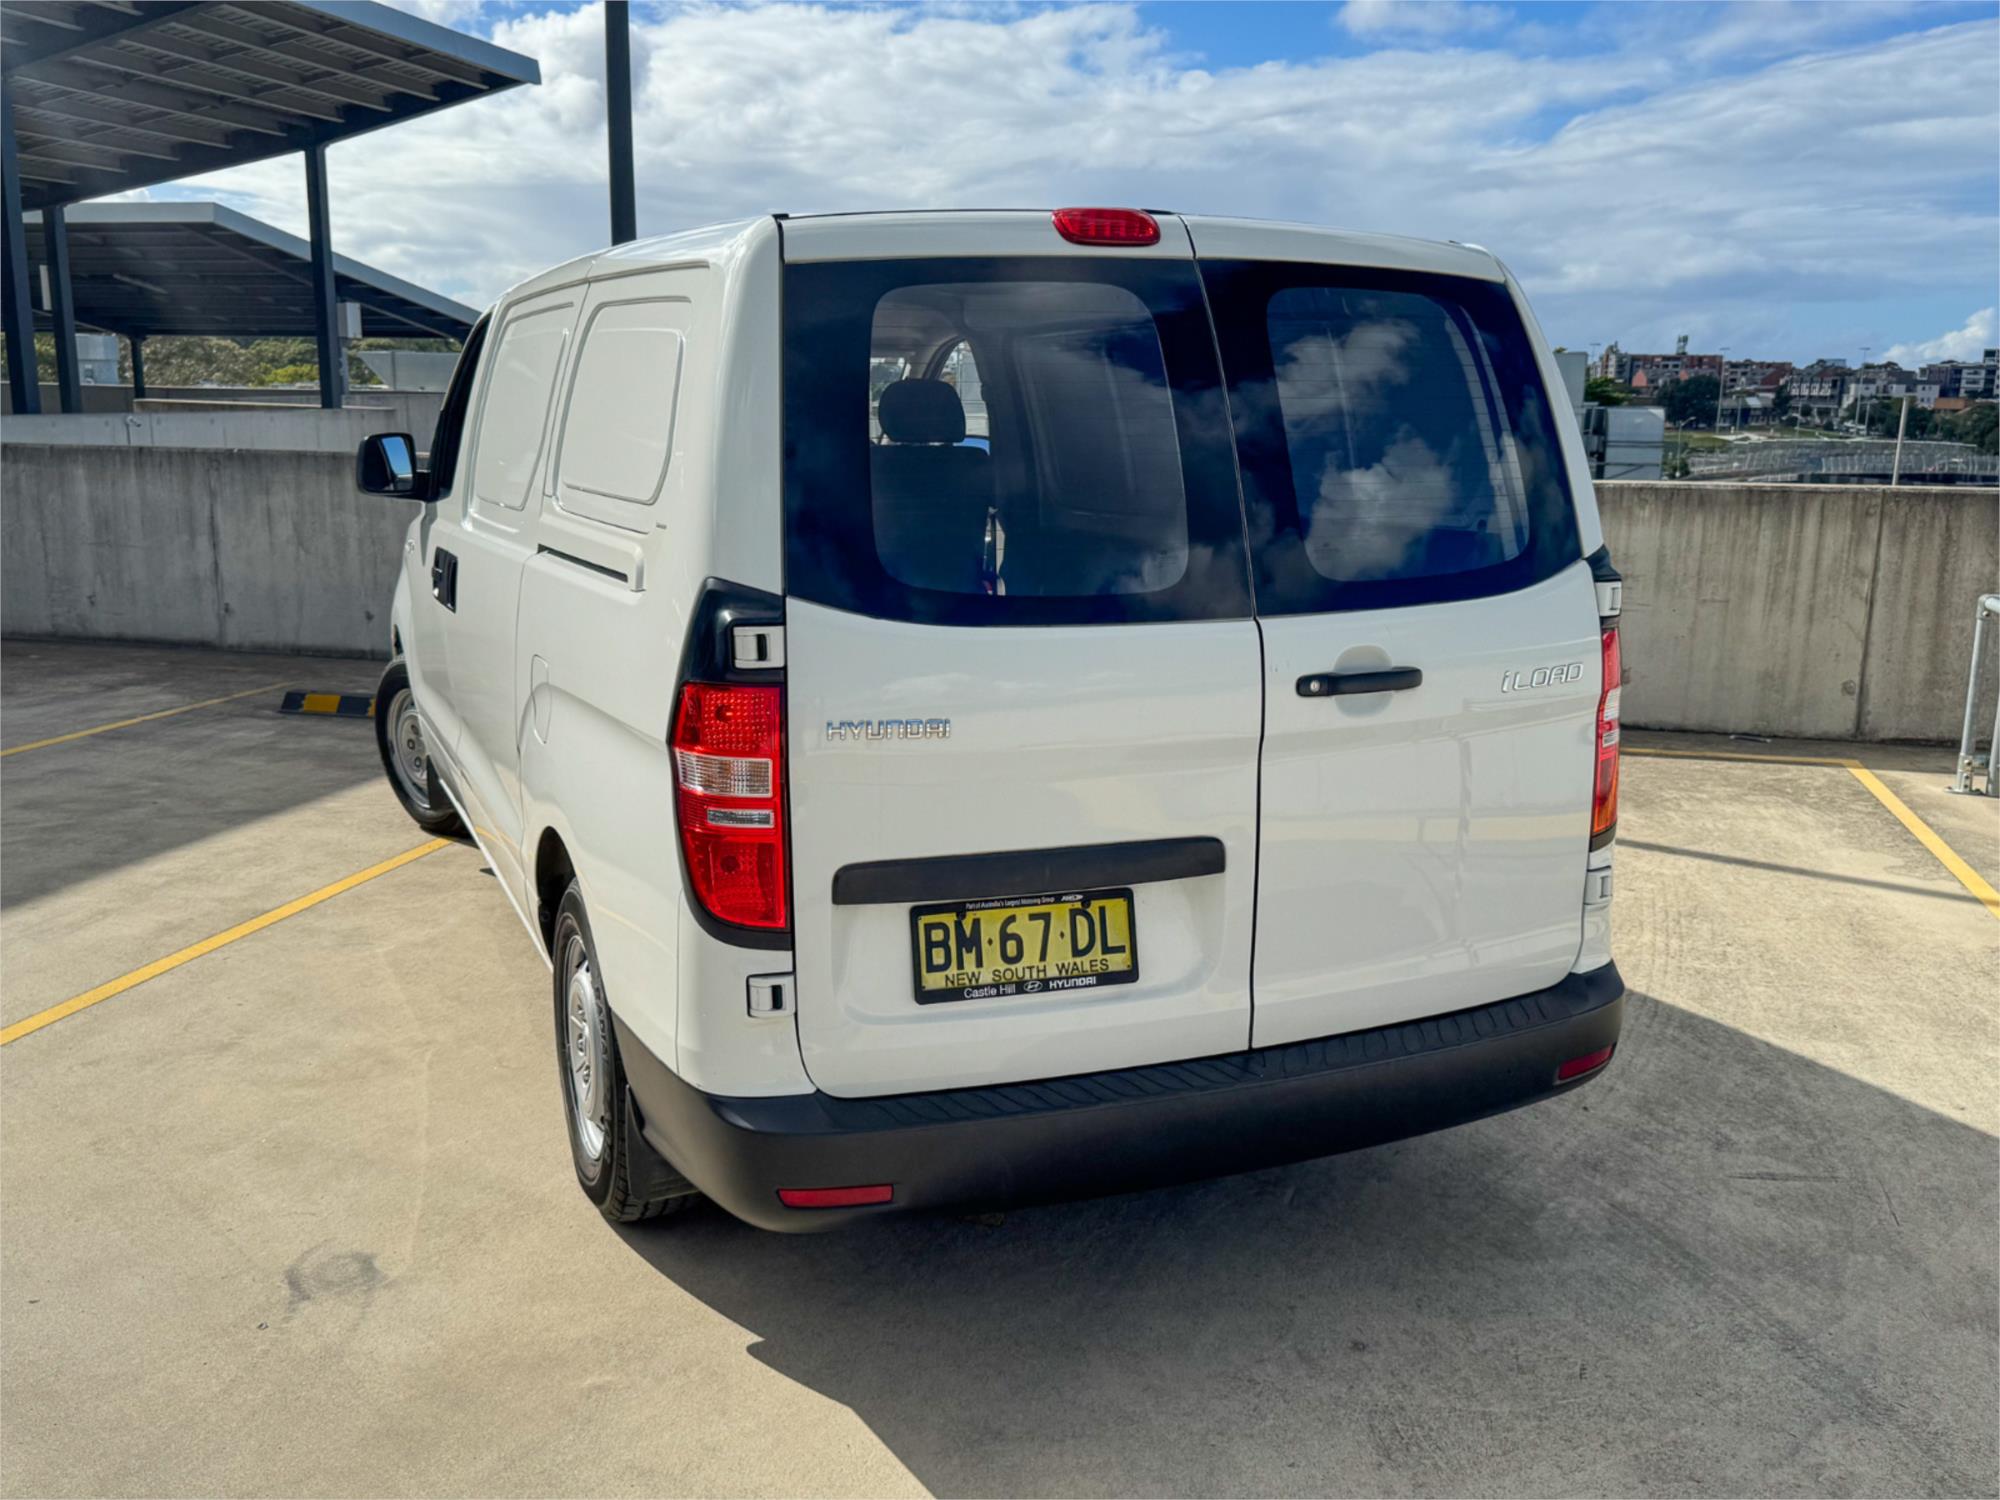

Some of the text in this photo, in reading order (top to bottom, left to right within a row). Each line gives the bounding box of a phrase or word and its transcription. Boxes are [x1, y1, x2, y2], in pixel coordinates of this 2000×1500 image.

[826, 719, 950, 741] HYUNDAI
[945, 958, 1109, 987] NEW SOUTH WALES
[964, 976, 1096, 999] Castle Hill HYUNDAI
